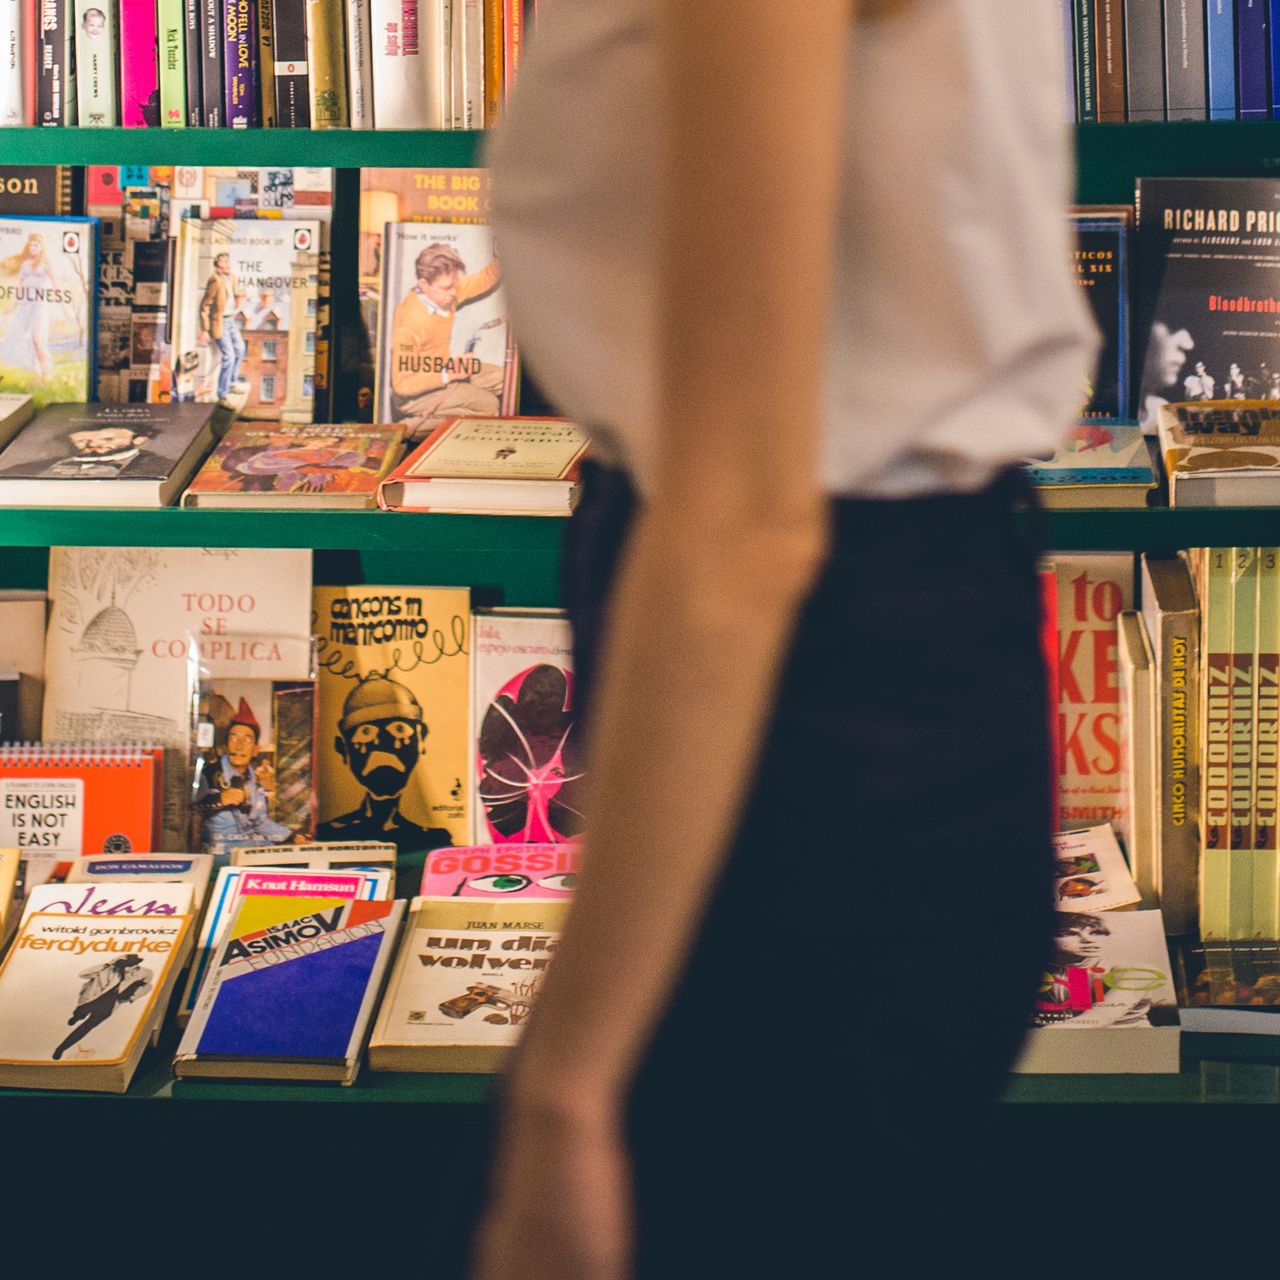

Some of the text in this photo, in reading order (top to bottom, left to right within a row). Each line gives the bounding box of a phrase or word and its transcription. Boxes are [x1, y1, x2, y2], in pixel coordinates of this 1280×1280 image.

[227, 5, 236, 42] MOON
[238, 13, 247, 33] FELL
[239, 35, 246, 43] IN
[384, 23, 399, 56] hijos de
[238, 43, 248, 68] LOVE
[414, 175, 480, 190] THE BIG
[428, 196, 478, 211] BOOK
[1164, 209, 1240, 232] RICHARD
[238, 261, 262, 272] THE
[237, 276, 308, 289] HANGOVER
[400, 344, 415, 352] THE
[398, 356, 482, 375] HUSBAND
[1215, 553, 1224, 569] 1
[1237, 553, 1248, 569] 2
[1264, 553, 1276, 570] 3
[182, 593, 256, 613] TODO
[1072, 570, 1121, 621] to
[201, 617, 228, 635] SE
[1172, 637, 1186, 826] CINCO HUMORISTAS DE HOY
[1207, 666, 1229, 826] CODORNIZ
[1231, 666, 1252, 826] CODORNIZ
[1257, 666, 1279, 826] CODORNIZ
[5, 794, 76, 809] ENGLISH
[12, 813, 67, 827] IS NOT
[18, 832, 61, 847] EASY
[431, 852, 580, 875] GOSSI
[245, 878, 355, 893] Knut Hamsun
[36, 886, 177, 915] Jean
[41, 926, 179, 937] witold gombrowicz
[266, 915, 313, 934] ISAAC
[19, 935, 172, 955] ferdydurke
[219, 905, 346, 967] ASIMOV
[426, 936, 492, 951] un
